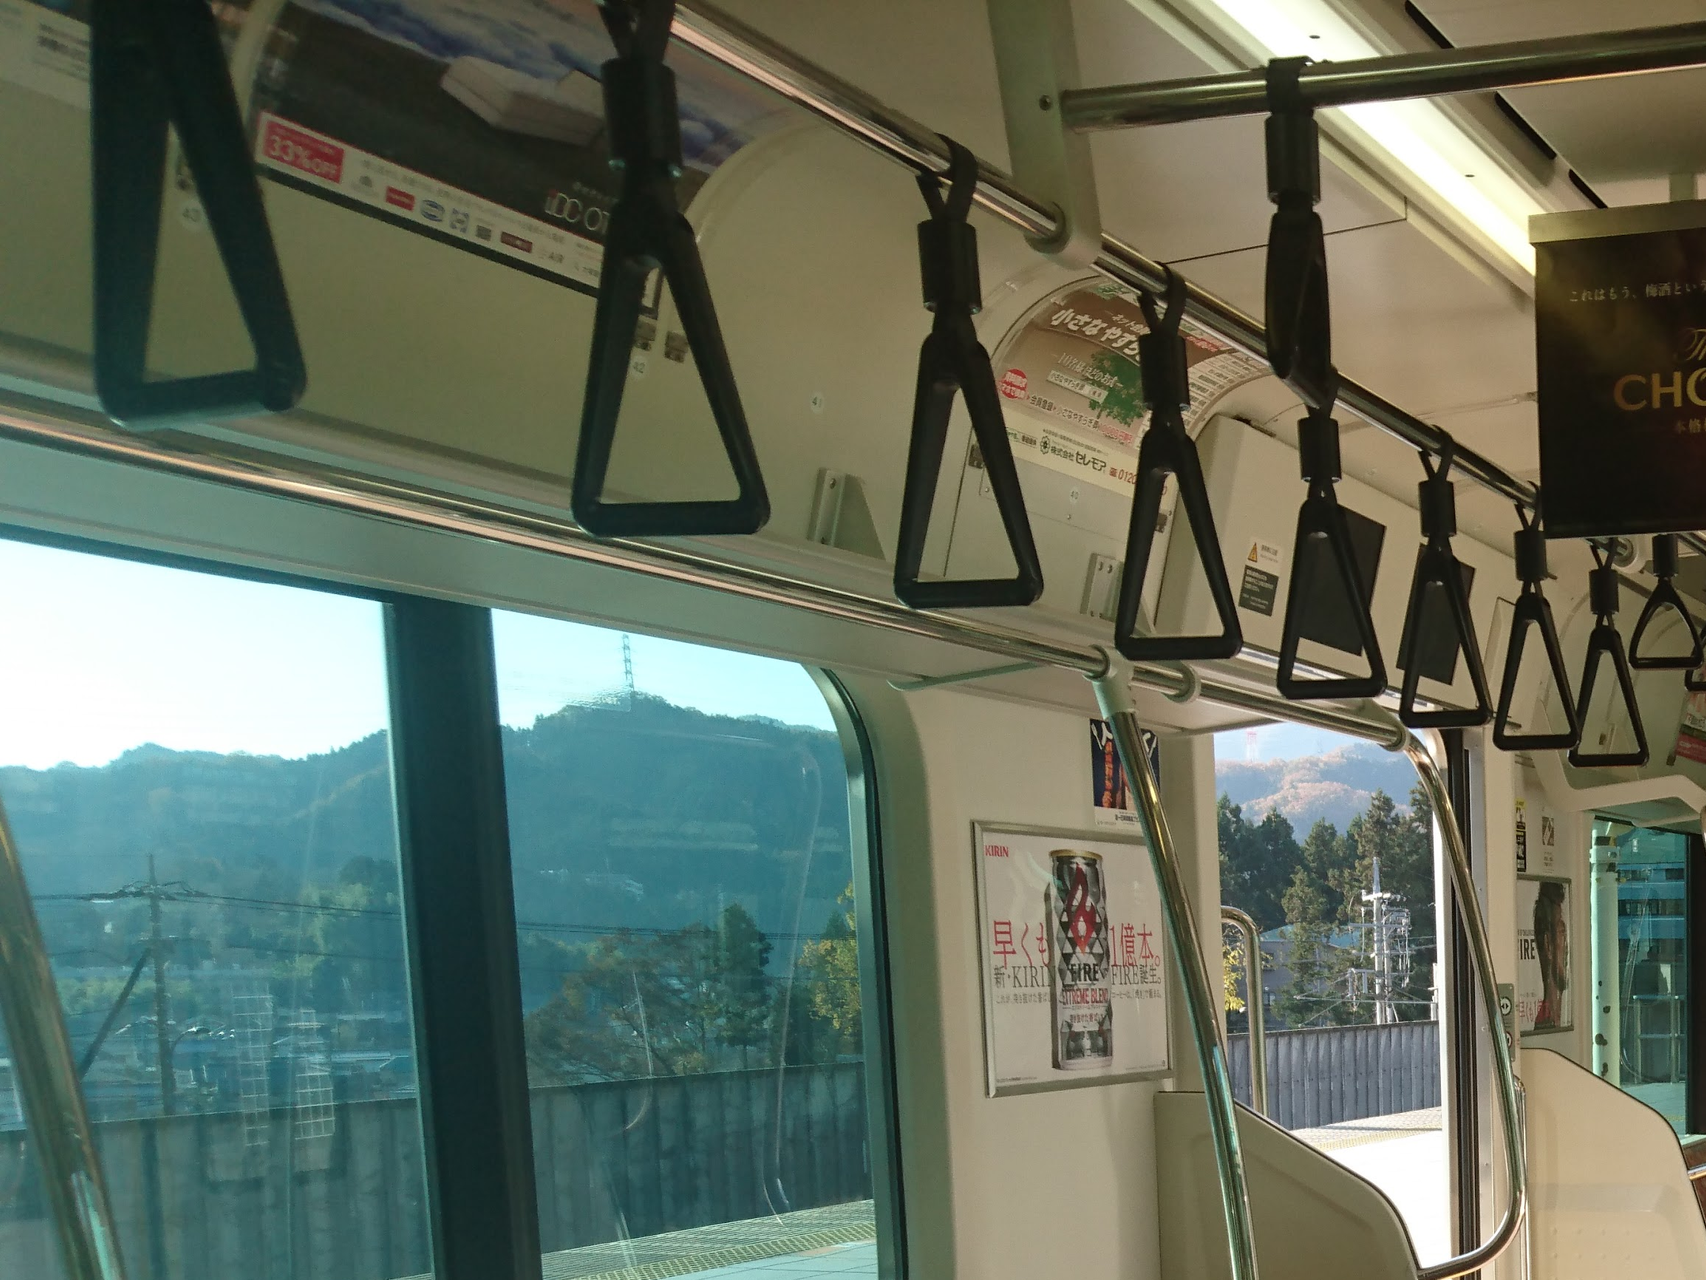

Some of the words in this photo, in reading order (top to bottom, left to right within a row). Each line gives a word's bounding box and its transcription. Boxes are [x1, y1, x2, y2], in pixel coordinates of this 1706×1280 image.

[984, 845, 1009, 858] KIRIN
[992, 919, 1052, 970] 早くも
[1109, 922, 1161, 968] 1億本。
[1519, 938, 1536, 960] IRE
[1069, 963, 1100, 982] FIRE
[1090, 987, 1109, 1004] BLEND
